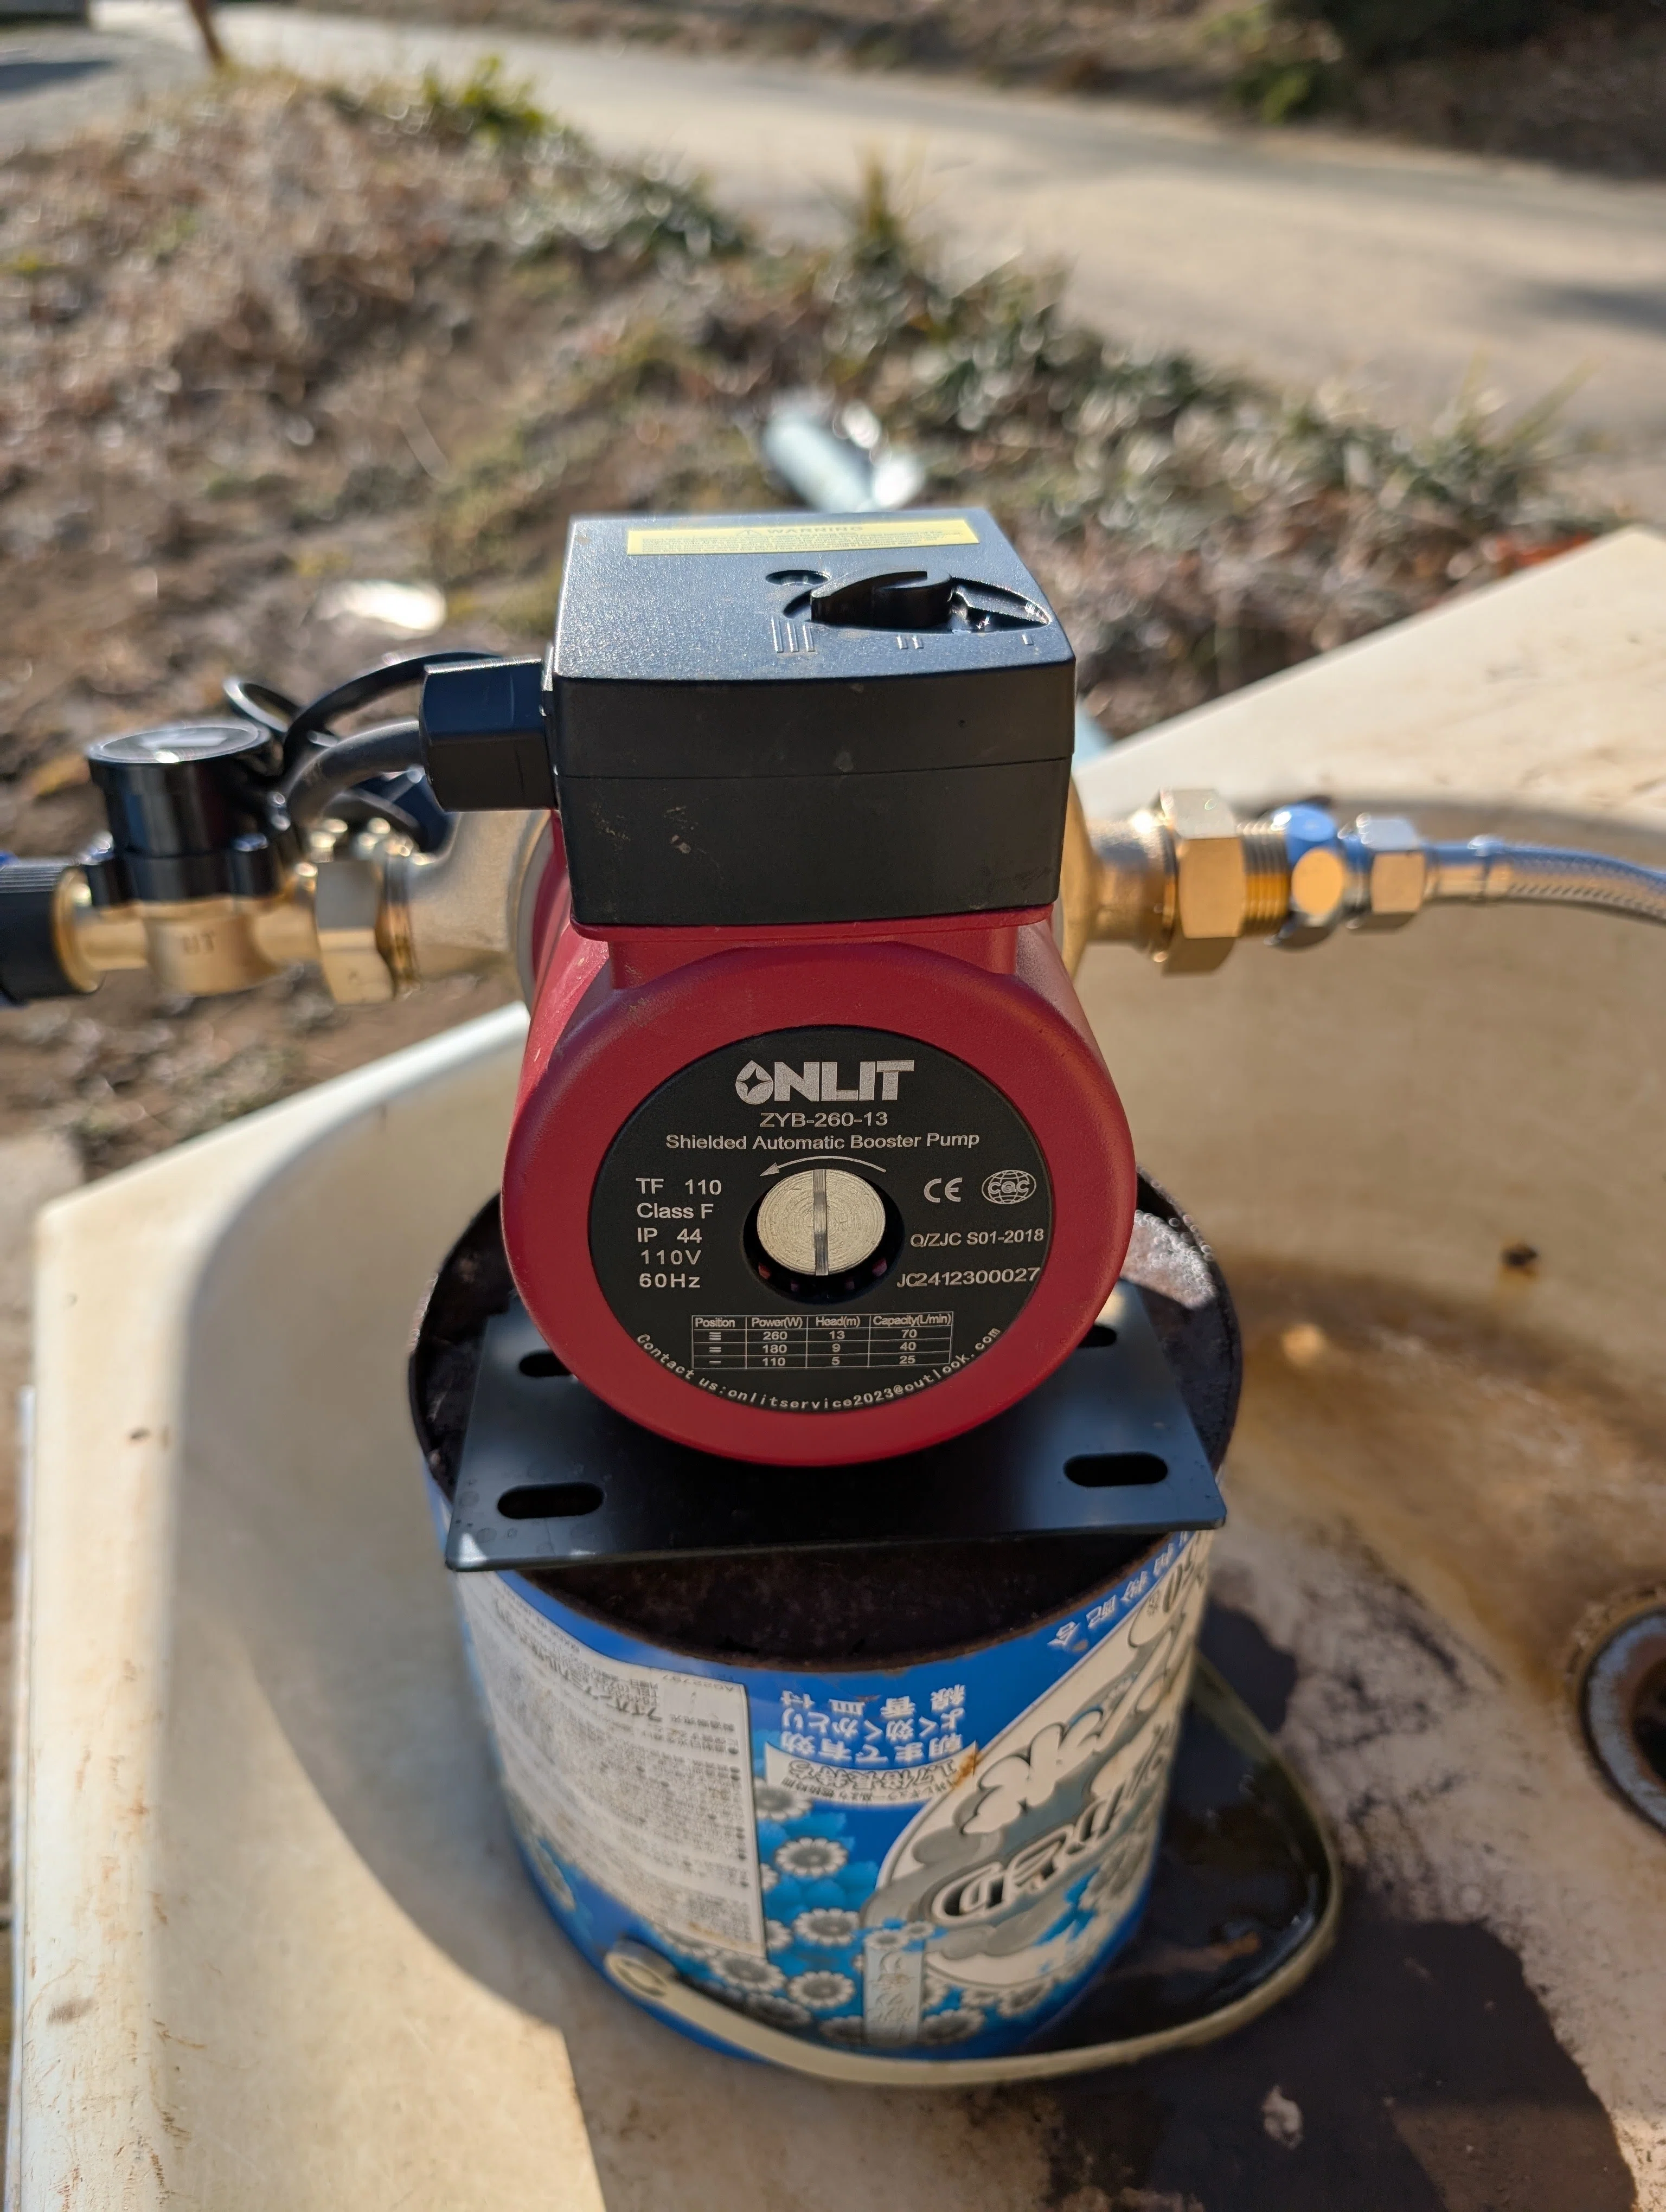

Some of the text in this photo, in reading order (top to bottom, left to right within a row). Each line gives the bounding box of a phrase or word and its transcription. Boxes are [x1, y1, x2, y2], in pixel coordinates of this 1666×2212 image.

[736, 1060, 915, 1105] ONLIT
[760, 1113, 888, 1127] ZYB-260-13
[667, 1134, 979, 1150] Shielded Automatic Booster Pump
[636, 1179, 722, 1195] TF 110
[925, 1178, 963, 1203] CE
[638, 1204, 714, 1219] Class F
[638, 1228, 702, 1243] IP 44
[911, 1229, 1044, 1248] Q/ZJC S01-2018
[642, 1250, 701, 1265] 110V
[640, 1274, 701, 1288] 60Hz
[898, 1268, 1040, 1287] JC2412300027
[695, 1314, 951, 1328] Position Power(W) Head(m) Capacity(L/min)
[764, 1330, 917, 1340] 260 13 70
[764, 1342, 917, 1353] 180 9 40
[637, 1334, 695, 1379] Contact
[764, 1358, 786, 1366] 110
[900, 1356, 916, 1365] 25
[780, 1683, 966, 1718] 線香皿付
[781, 1707, 966, 1743] よく効くかとり
[780, 1731, 964, 1764] 朝まで有効
